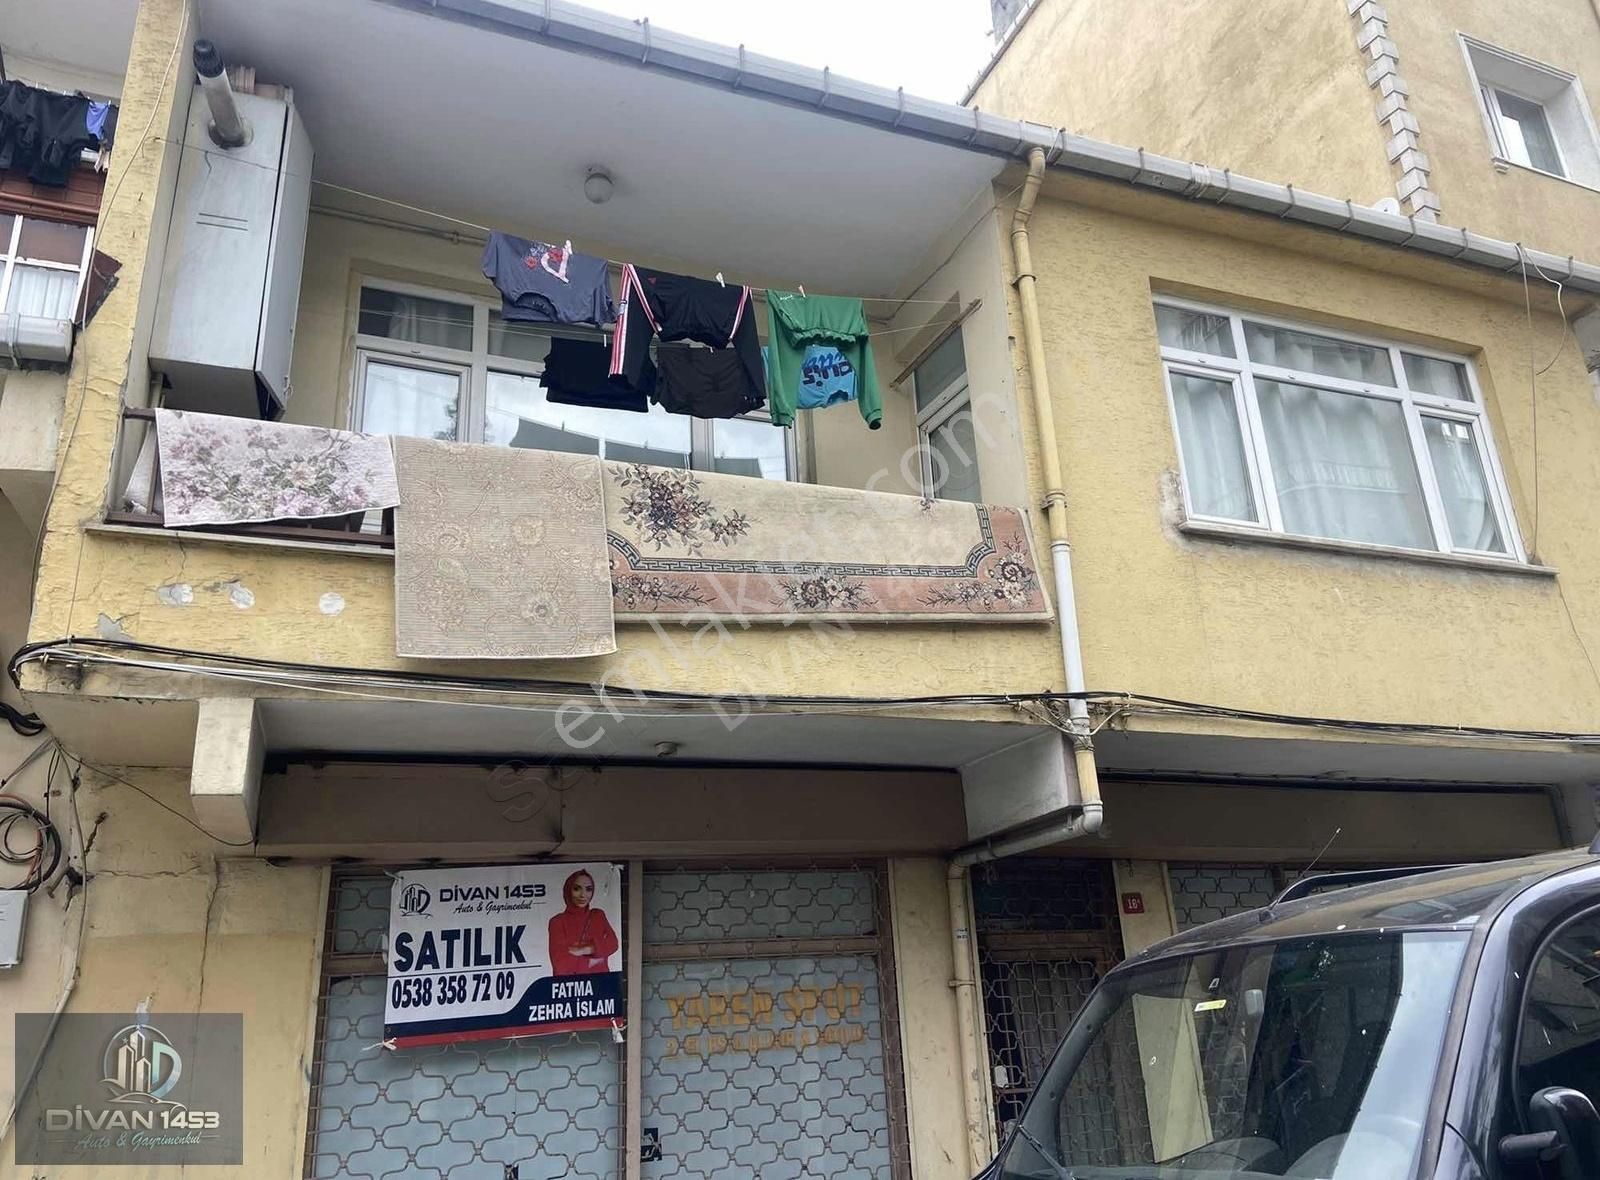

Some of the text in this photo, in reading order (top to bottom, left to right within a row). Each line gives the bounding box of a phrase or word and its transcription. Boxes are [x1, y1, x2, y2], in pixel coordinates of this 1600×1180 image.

[439, 884, 546, 902] DİVAN 1453
[453, 901, 532, 915] Auto & Gayrimenkul
[394, 925, 527, 972] SATILIK
[392, 971, 515, 1009] 0538 358 72 09
[551, 980, 594, 999] FATMA
[528, 999, 615, 1021] ZEHRA İSLAM
